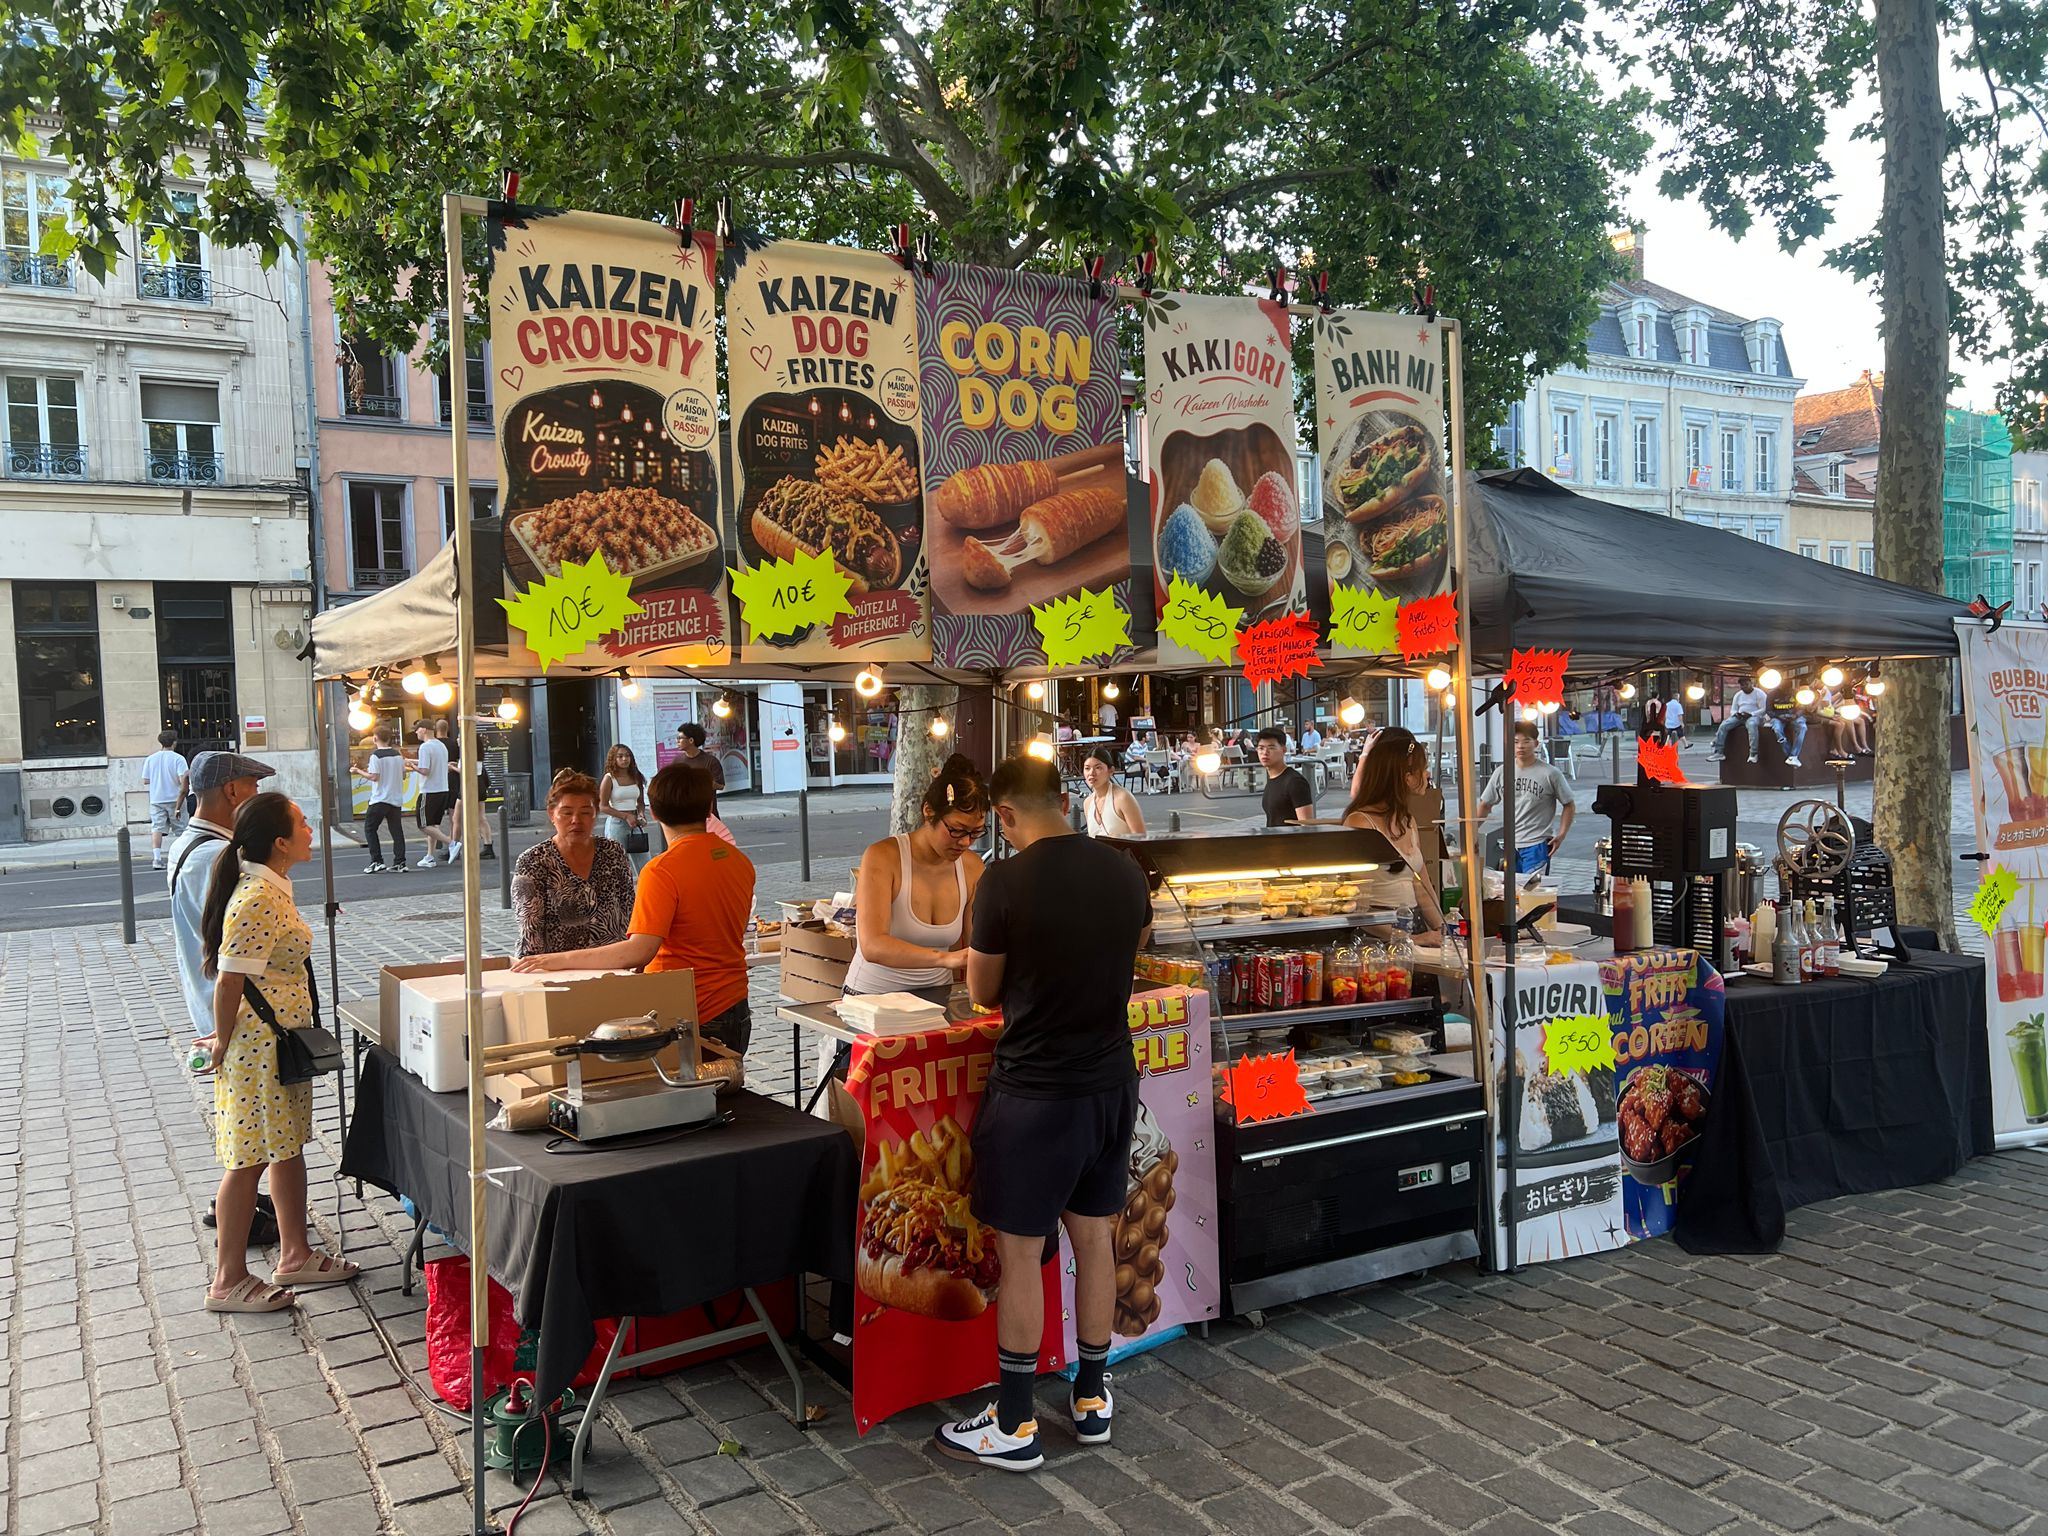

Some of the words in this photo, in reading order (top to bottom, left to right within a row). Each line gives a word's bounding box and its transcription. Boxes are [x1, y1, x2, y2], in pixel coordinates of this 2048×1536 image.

[519, 264, 698, 328] KAIZEN
[758, 275, 898, 325] KAIZEN
[517, 315, 703, 377] CROUSTY
[792, 315, 869, 357] DOG
[940, 321, 1092, 385] CORN
[1162, 339, 1286, 389] KAKIGORI
[787, 358, 875, 389] FRITES
[887, 381, 914, 393] MAISON
[1331, 349, 1399, 394] BANH
[1407, 355, 1435, 395] MI
[675, 402, 708, 417] MAISON
[686, 397, 699, 405] FAIT
[887, 397, 916, 409] PASSION
[959, 377, 1078, 435] DOG
[1173, 394, 1220, 417] Kaizen
[1221, 392, 1270, 411] Washoku
[522, 410, 585, 444] Kaizen
[673, 420, 710, 436] PASSION
[684, 415, 699, 423] AVEC
[762, 417, 799, 435] KAIZEN
[756, 434, 778, 447] DOG
[780, 436, 808, 450] FRITES
[531, 445, 591, 476] Crousty
[680, 597, 698, 614] LA
[772, 579, 816, 610] 10€
[886, 599, 897, 611] LA
[549, 585, 604, 637] 10€
[842, 614, 899, 638] DIFFÉRENCE
[1064, 605, 1096, 641] 5€
[1173, 599, 1228, 640] 5€50
[1340, 607, 1381, 632] 10€
[618, 617, 702, 647] DIFFÉRENCE
[1991, 669, 2048, 690] BUBBL
[2010, 695, 2040, 713] TEA
[1503, 983, 1598, 1019] NIGIRI
[1629, 974, 1687, 1010] FRITS
[1127, 995, 1187, 1030] BLE
[1132, 1032, 1187, 1073] FLE
[1559, 1032, 1600, 1054] 5€50
[871, 1053, 993, 1119] FRITE
[1257, 1073, 1276, 1099] 5€
[1527, 1176, 1588, 1211] おにぎり
